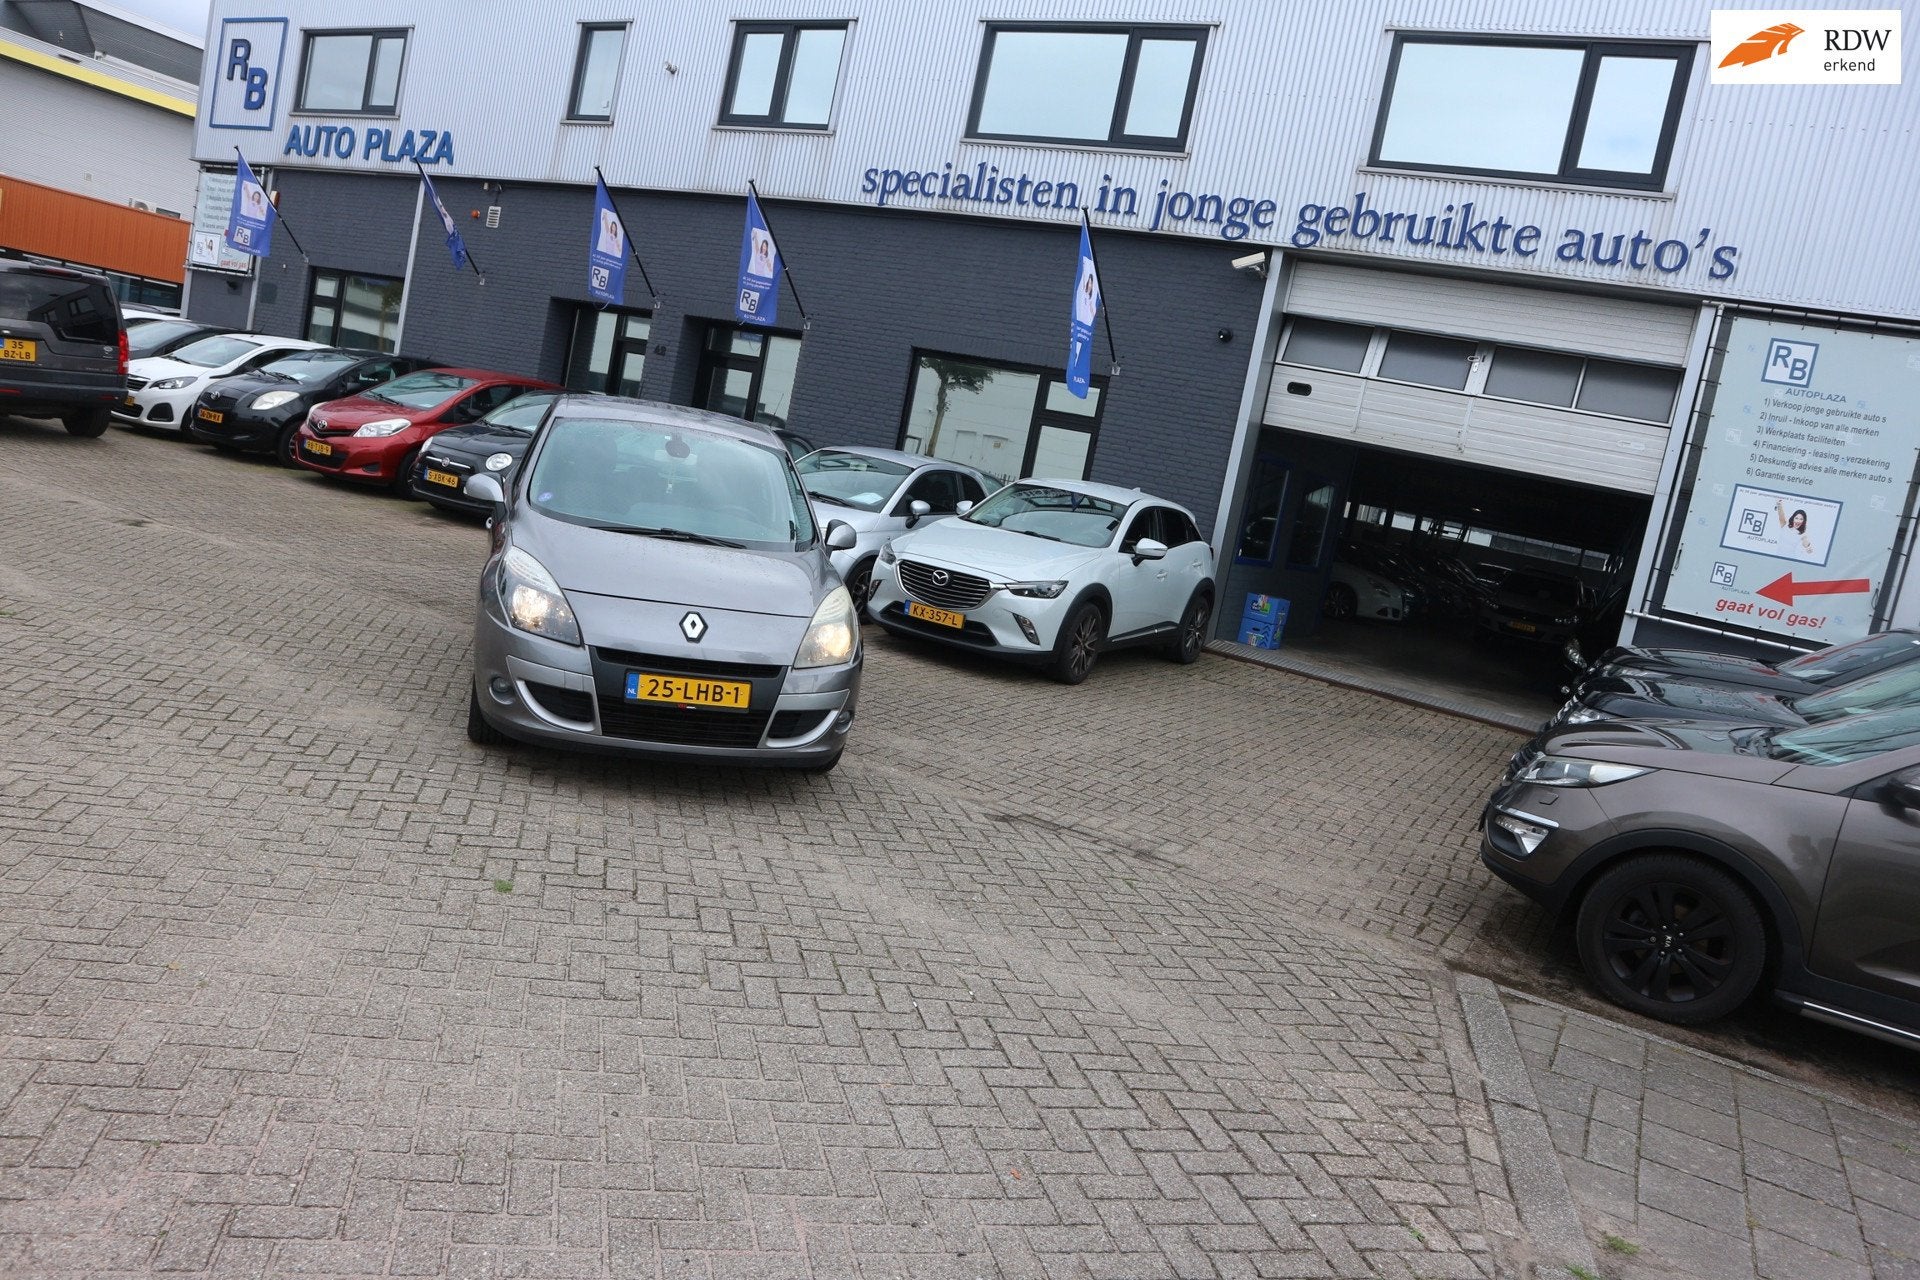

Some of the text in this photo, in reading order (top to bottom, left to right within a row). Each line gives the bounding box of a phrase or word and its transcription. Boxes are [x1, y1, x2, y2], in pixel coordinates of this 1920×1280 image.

[283, 125, 454, 166] AUTO PLAZA
[862, 161, 1738, 280] specialisten in jonge gebruikte auto's
[592, 268, 607, 288] RB
[741, 291, 757, 311] RB
[3, 349, 31, 360] BZ-LB
[11, 340, 25, 349] 35
[1772, 345, 1808, 381] RB
[1785, 388, 1847, 403] AUTOPLAZA
[1764, 398, 1771, 408] 1)
[1772, 398, 1802, 412] Verkoop
[1803, 404, 1825, 415] jonge
[1826, 408, 1862, 419] gebruikte
[1760, 411, 1767, 421] 2)
[1769, 413, 1788, 423] Inruil
[1793, 417, 1819, 429] Inkoop
[1820, 422, 1834, 430] van
[1836, 424, 1849, 433] alle
[1851, 427, 1880, 437] merken
[1757, 425, 1846, 447] 3) Werkplaats faciliteiten
[1753, 440, 1760, 449] 4)
[1761, 441, 1807, 457] Financiering
[1813, 449, 1840, 462] leasing
[1846, 456, 1891, 470] verzekering
[1746, 467, 1814, 486] 6) Garantie service
[1750, 453, 1757, 463] 5)
[1758, 454, 1798, 470] Deskundig
[1798, 462, 1823, 473] advies
[1823, 466, 1838, 475] alle
[1839, 469, 1867, 480] merken
[1744, 512, 1763, 533] RB
[1746, 535, 1778, 545] AUTOPLAZA
[1715, 565, 1733, 584] RB
[1721, 586, 1750, 595] AUTOPLAZA
[912, 604, 958, 626] KX-357-L
[1715, 598, 1827, 629] gaat vol gas!
[647, 678, 740, 704] 25-LHB-1
